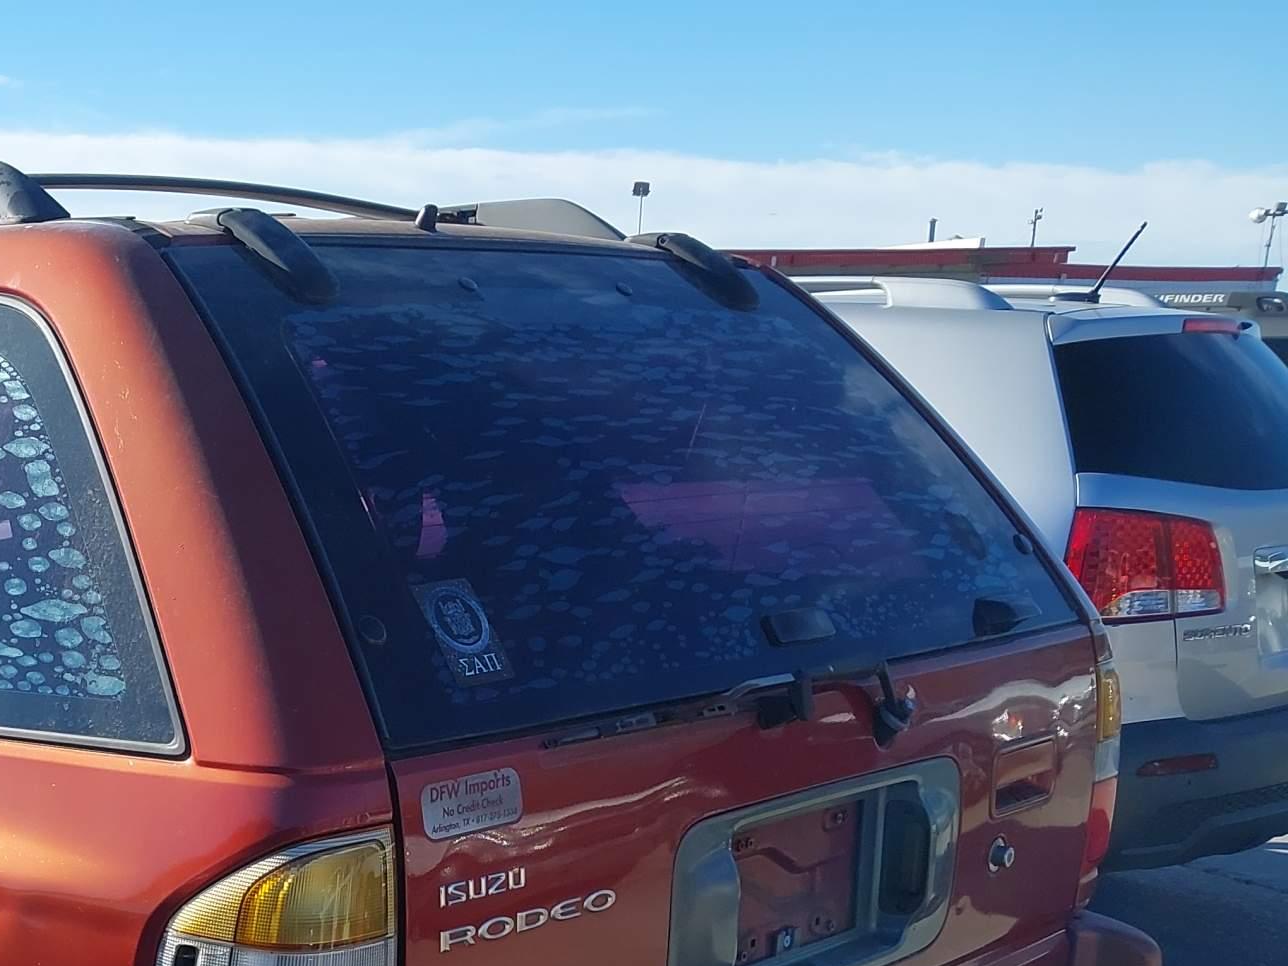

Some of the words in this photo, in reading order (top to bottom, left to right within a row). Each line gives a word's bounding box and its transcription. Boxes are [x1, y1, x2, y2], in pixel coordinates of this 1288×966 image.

[430, 781, 460, 804] DFW
[465, 773, 512, 797] Imports
[442, 806, 455, 818] No
[456, 800, 480, 815] Credit
[481, 794, 504, 809] Check
[440, 865, 526, 909] ISUZU
[440, 889, 616, 953] RODEO
